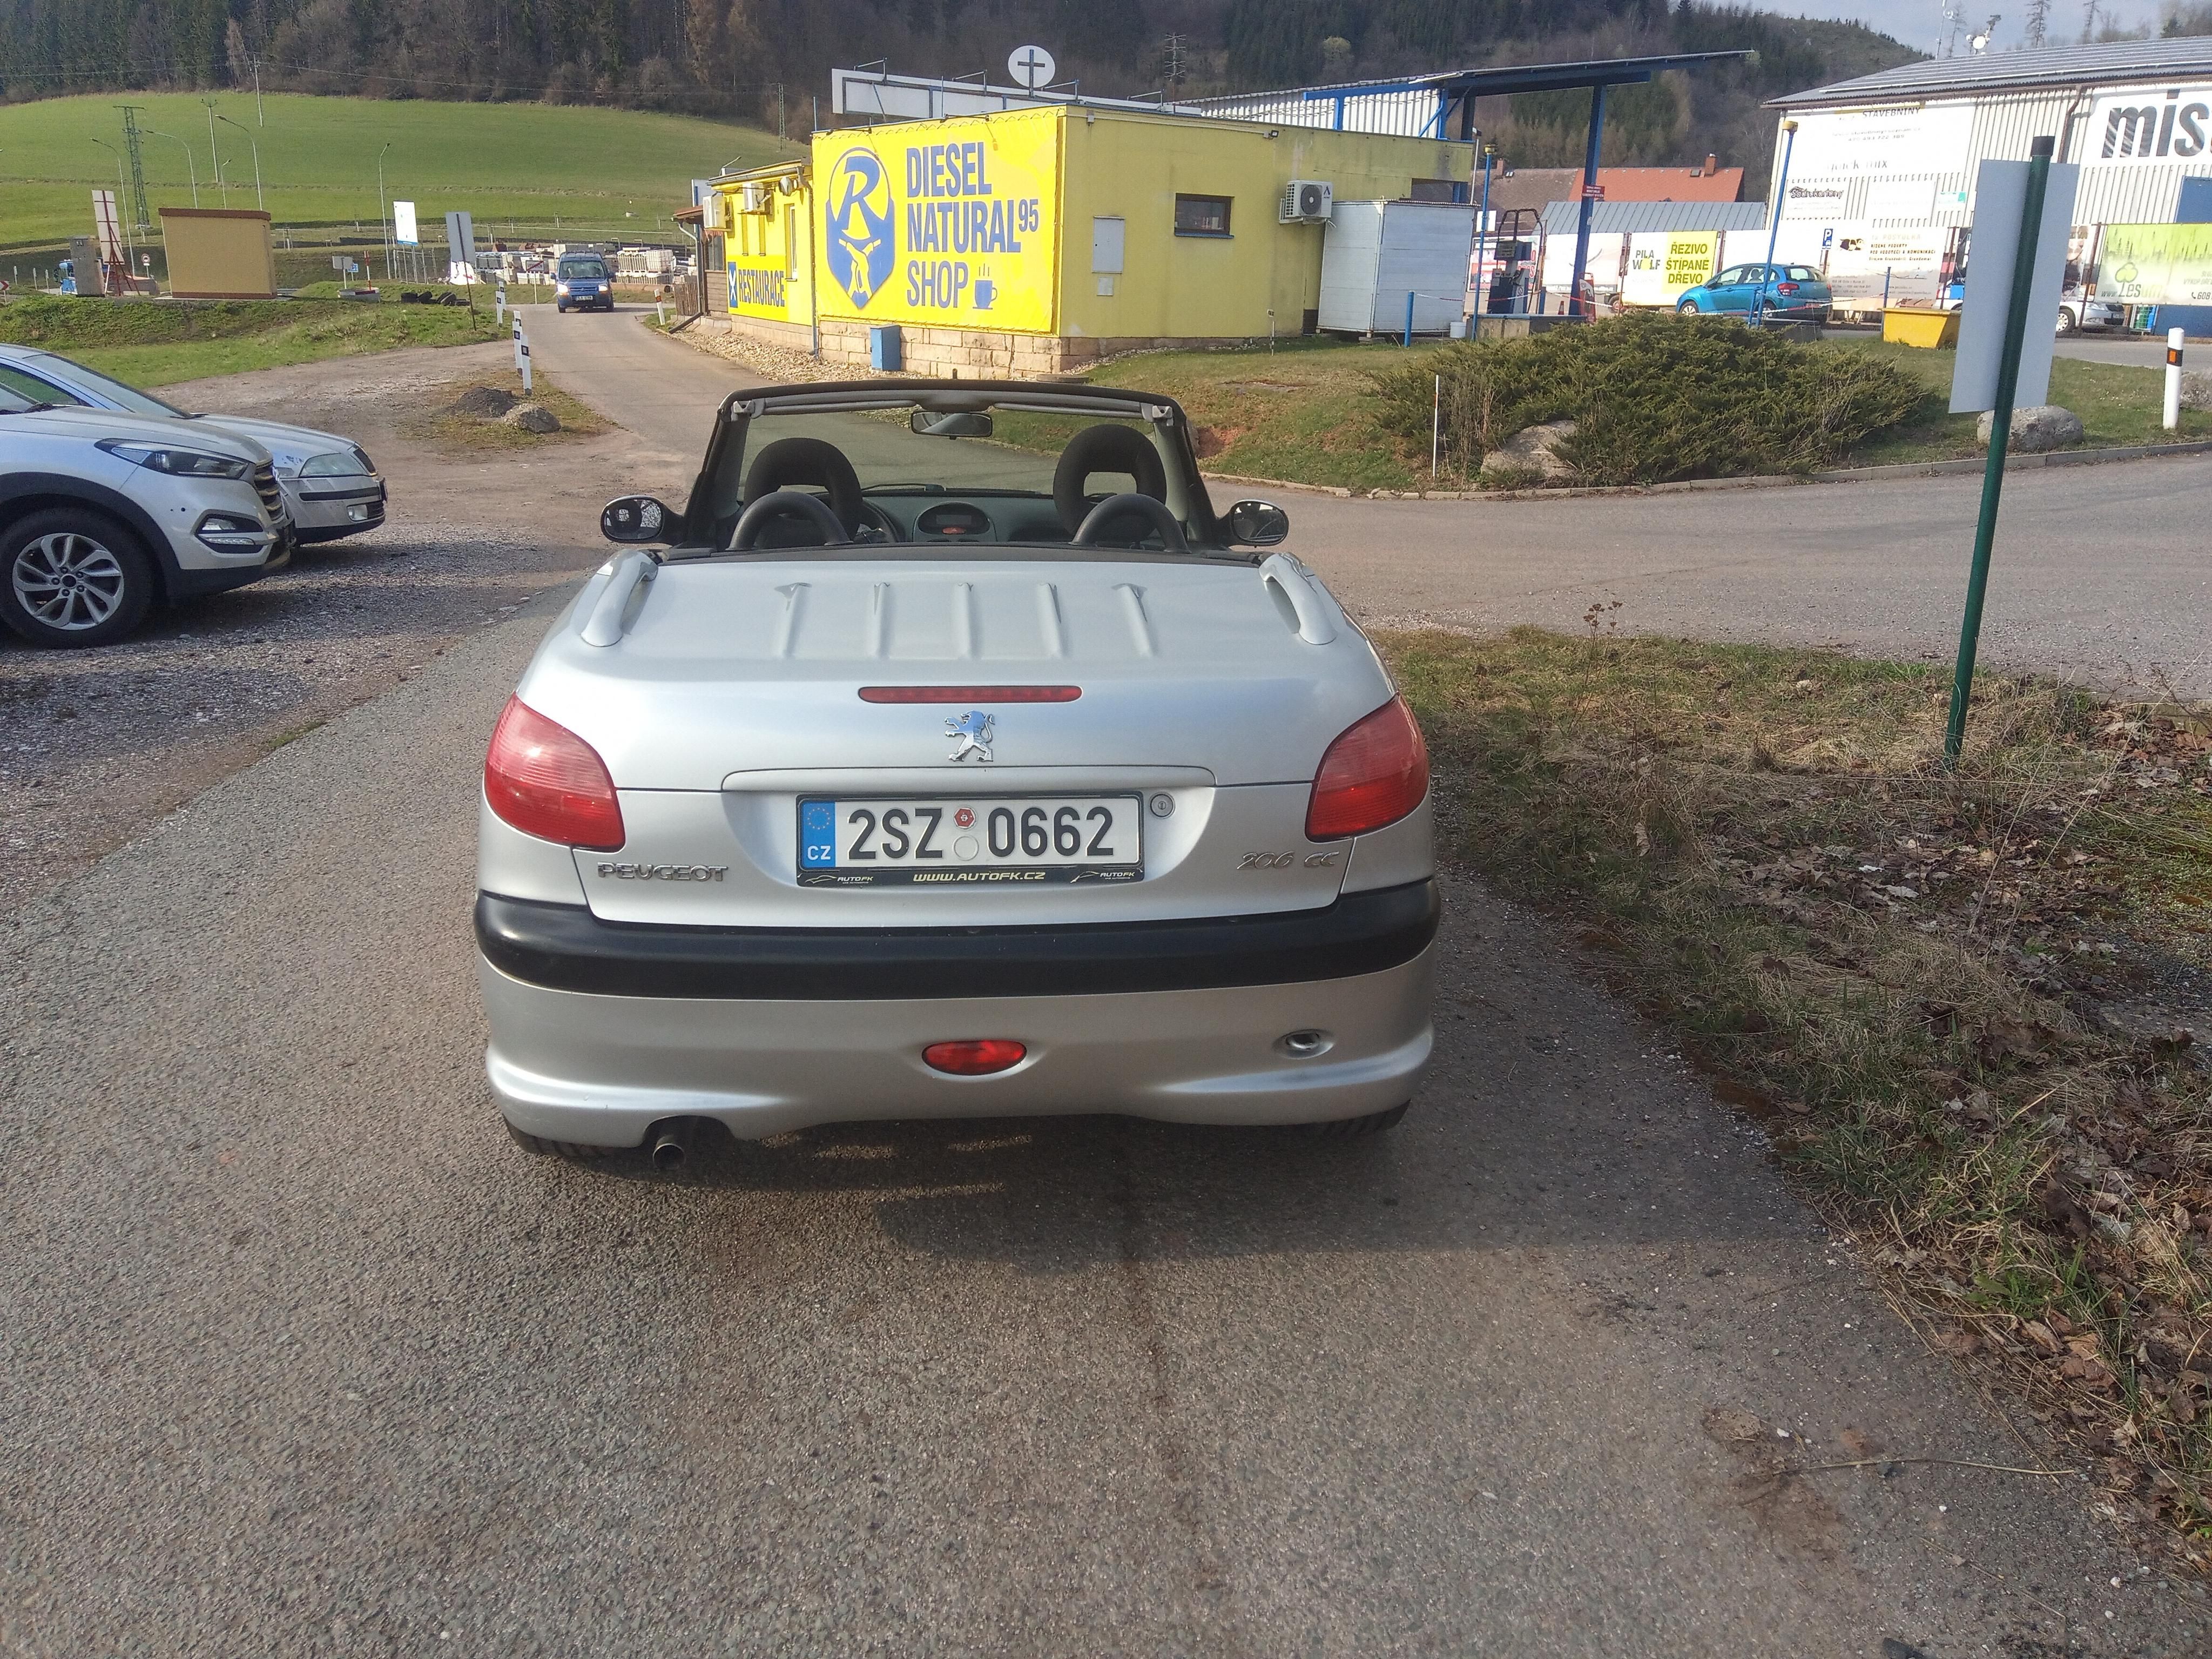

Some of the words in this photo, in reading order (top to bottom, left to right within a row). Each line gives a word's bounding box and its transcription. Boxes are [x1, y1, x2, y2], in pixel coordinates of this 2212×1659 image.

[1863, 107, 1921, 118] STAVEBNINY
[2101, 89, 2212, 158] mis
[907, 142, 992, 198] DIESEL
[907, 200, 1021, 253] NATURAL
[1019, 199, 1039, 232] 95
[1636, 250, 1654, 258] PILA
[1671, 242, 1708, 254] ŘEZIVO
[1666, 258, 1709, 270] ŠTÍPANÉ
[907, 260, 968, 308] SHOP
[1668, 271, 1703, 284] DŘEVO
[738, 269, 785, 307] RESTAURACE
[847, 807, 943, 860] 2SZ
[986, 806, 1114, 858] 0662
[807, 845, 831, 860] CZ
[1236, 851, 1294, 870] 206
[1304, 851, 1339, 868] CC
[597, 862, 729, 882] PEUGEOT
[913, 872, 1046, 881] WWW.AUTOFK.CZ
